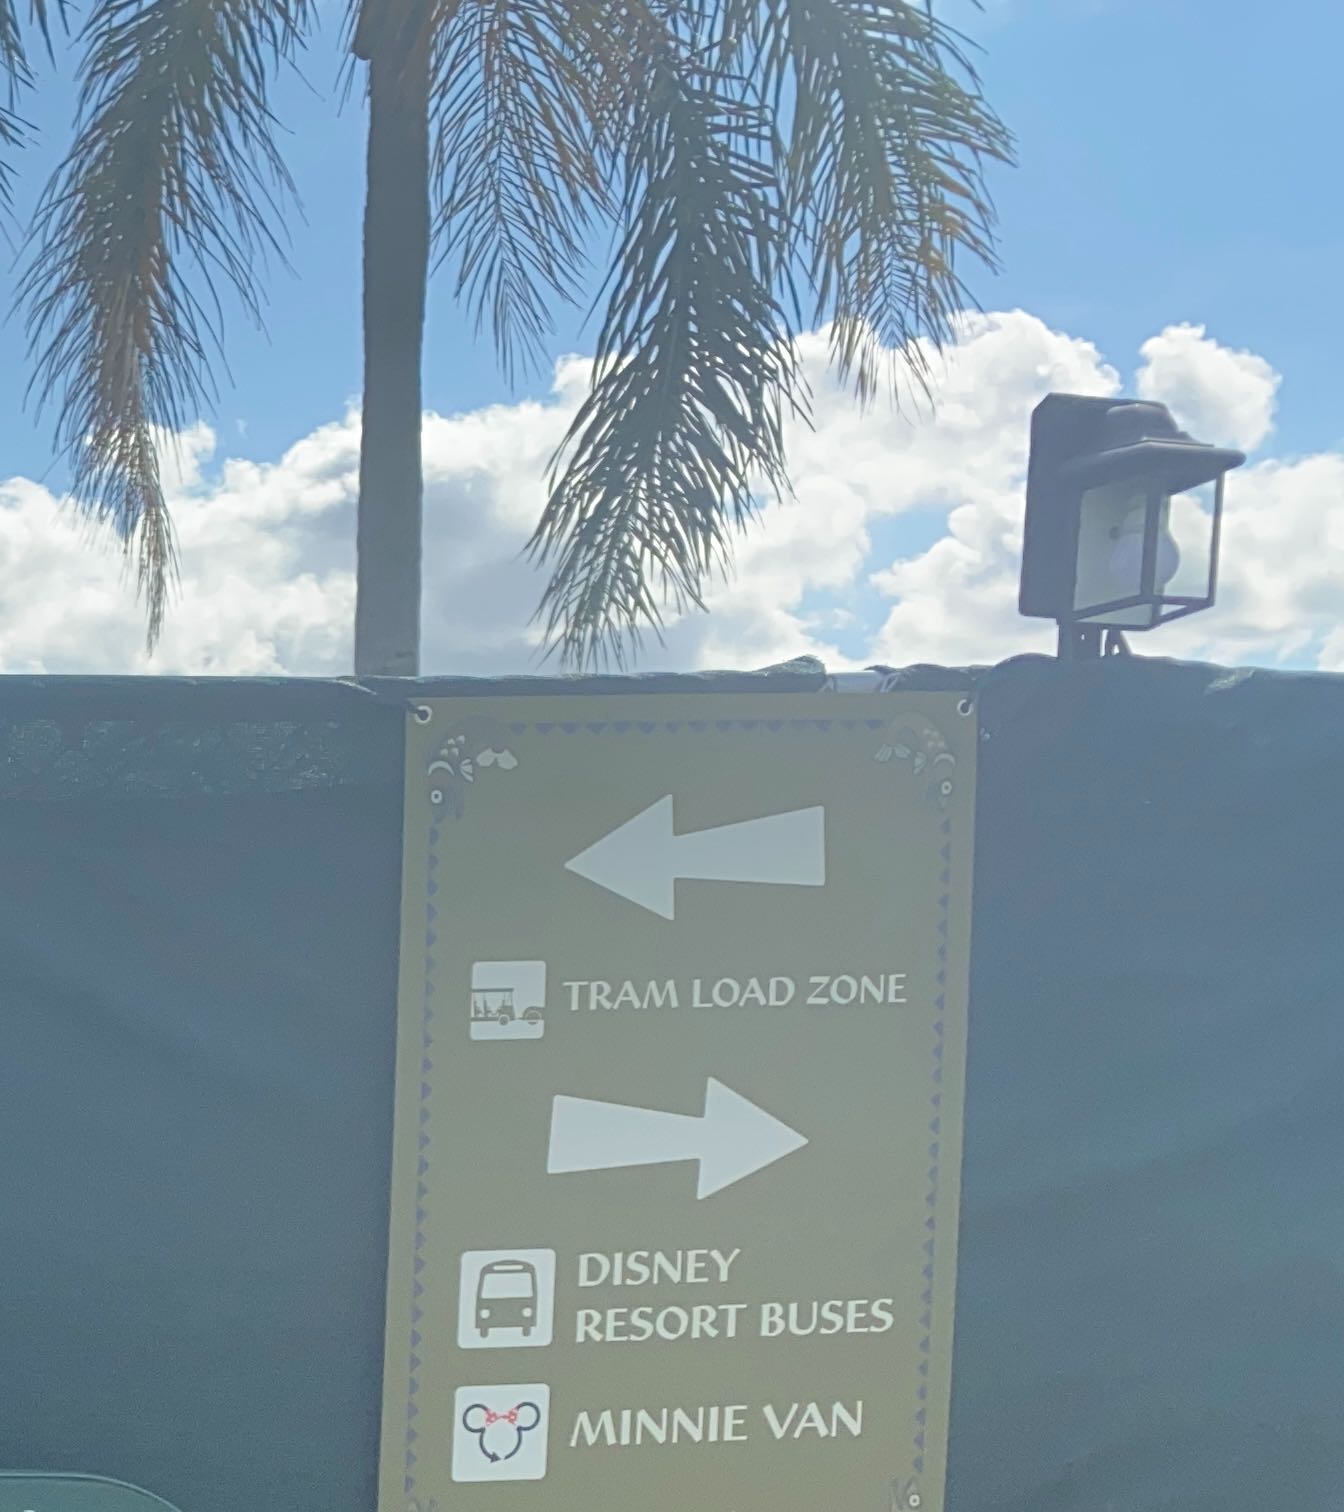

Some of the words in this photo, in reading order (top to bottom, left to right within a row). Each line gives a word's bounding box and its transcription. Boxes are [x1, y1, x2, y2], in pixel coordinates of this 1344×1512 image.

[563, 979, 678, 1011] TRAM
[692, 976, 795, 1008] LOAD
[806, 973, 906, 1005] ZONE
[578, 1248, 741, 1287] DISNEY
[575, 1304, 747, 1344] RESORT
[759, 1298, 894, 1337] BUSES
[569, 1405, 748, 1448] MINNIE
[763, 1400, 864, 1440] VAN
